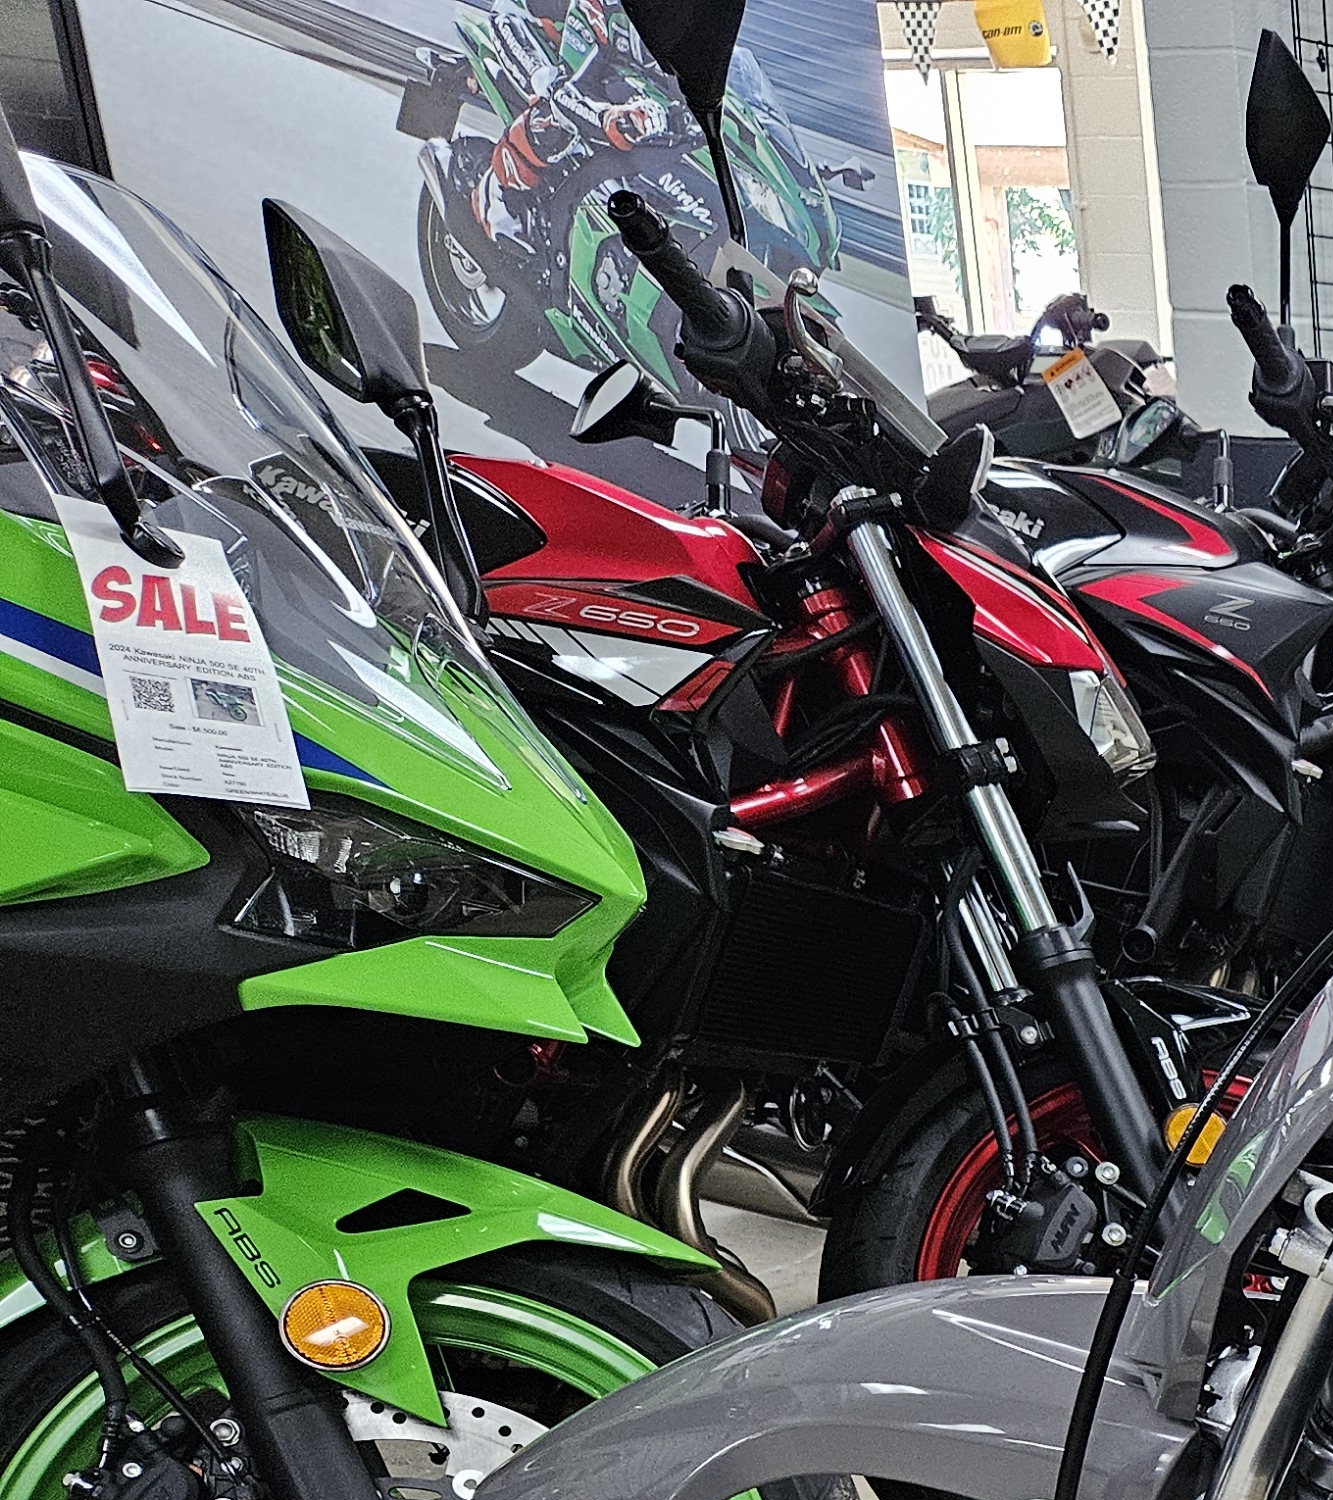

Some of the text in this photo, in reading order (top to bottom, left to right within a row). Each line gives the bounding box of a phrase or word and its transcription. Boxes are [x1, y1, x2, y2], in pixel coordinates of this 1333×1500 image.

[982, 25, 1022, 39] can-am
[658, 172, 714, 227] Ninja
[91, 565, 250, 643] SALE
[579, 605, 700, 637] 650
[1203, 615, 1251, 631] 650
[109, 644, 265, 675] 2024 Kawasaki NINJA 500 SE 40TH
[123, 654, 256, 681] ANNIVERSARY EDITION ABS
[1151, 1037, 1187, 1099] ABS
[214, 1208, 280, 1288] ABS
